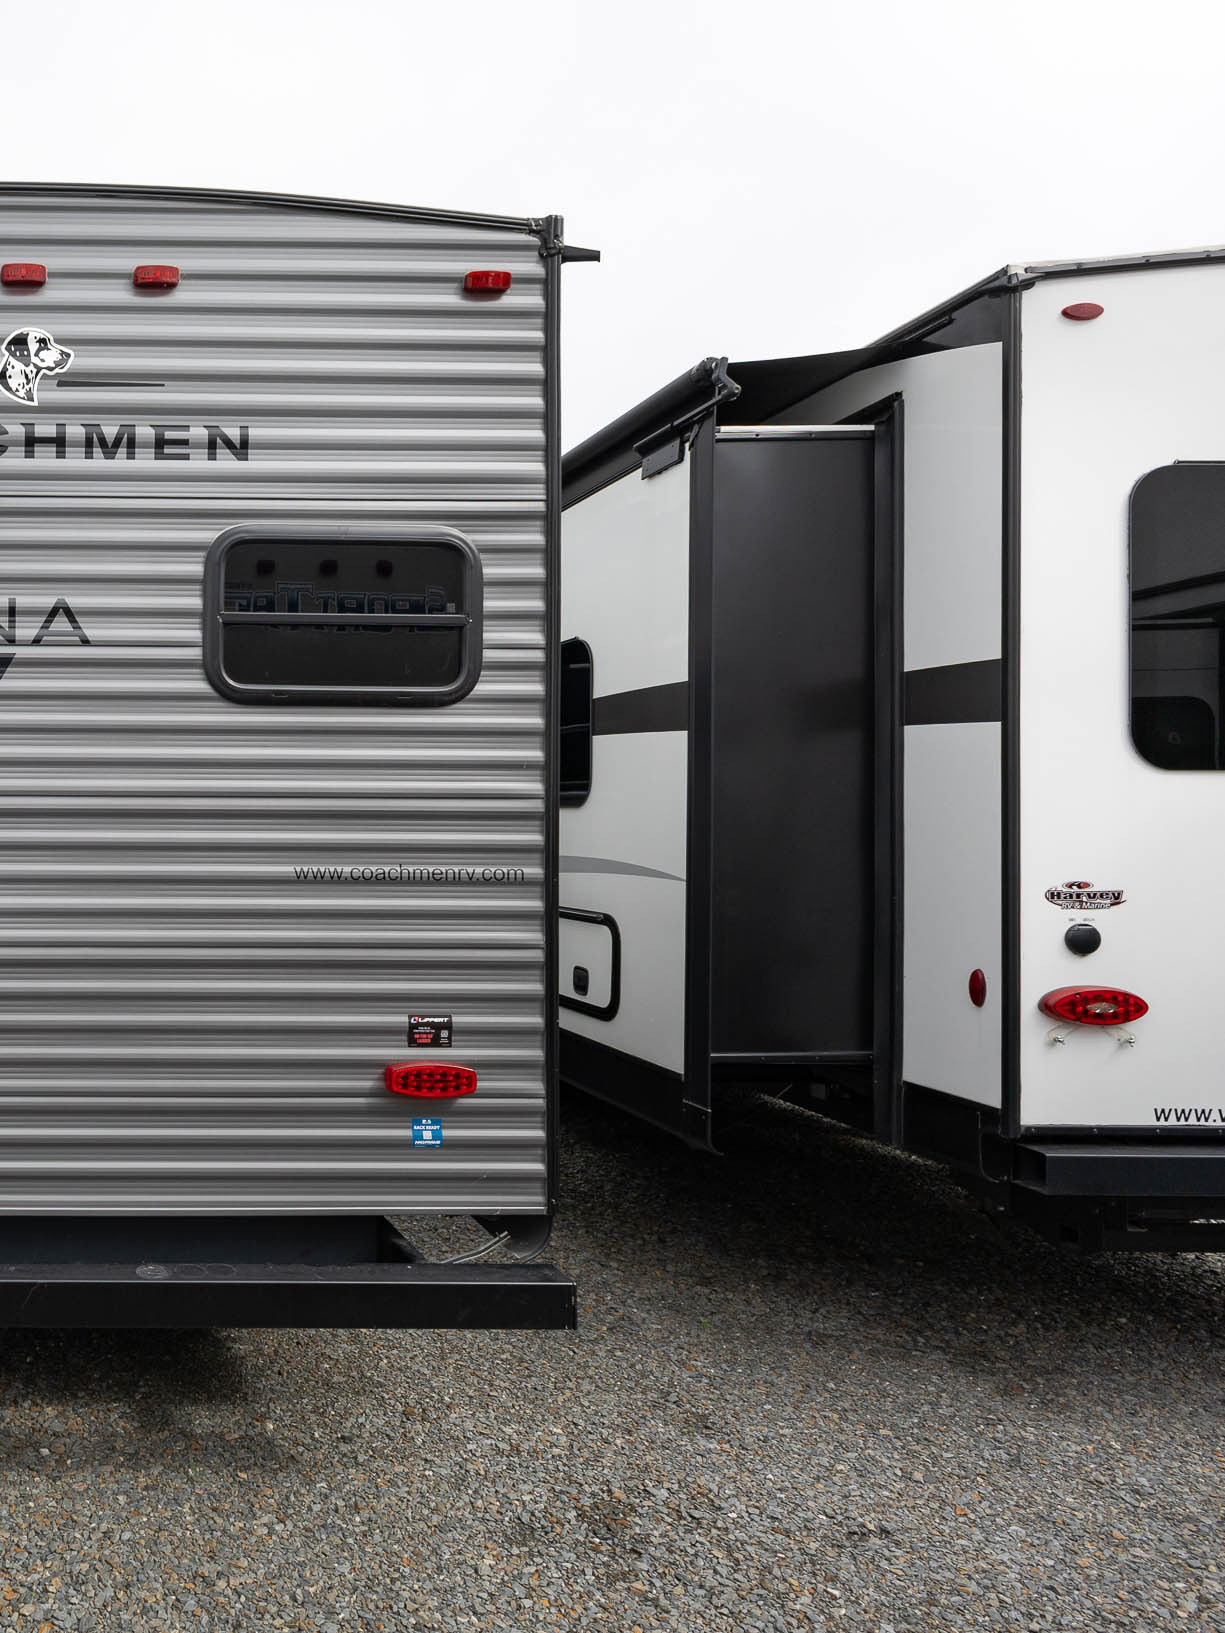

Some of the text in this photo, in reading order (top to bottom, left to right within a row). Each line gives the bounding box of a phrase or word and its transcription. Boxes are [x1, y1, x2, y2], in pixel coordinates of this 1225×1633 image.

[293, 863, 525, 882] www.coachmenrv.com
[1048, 890, 1122, 901] Harvey
[1082, 902, 1111, 910] Marine
